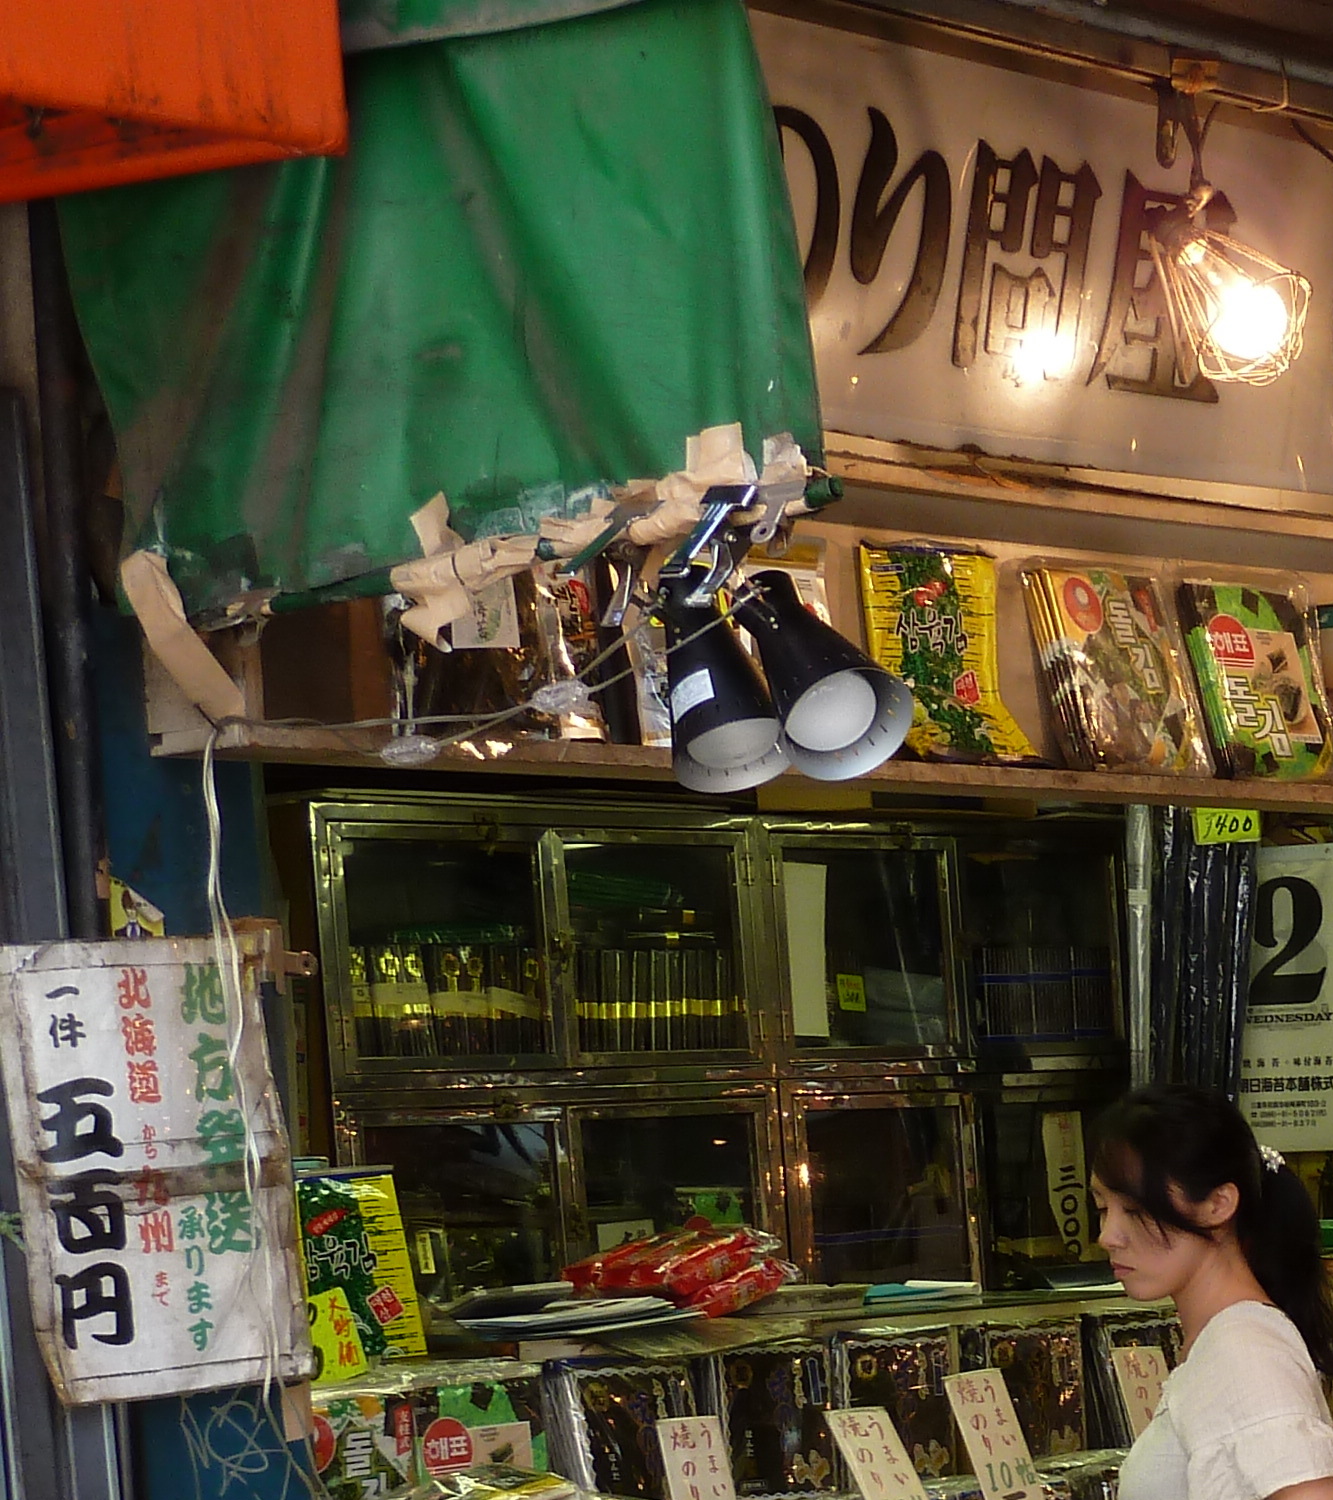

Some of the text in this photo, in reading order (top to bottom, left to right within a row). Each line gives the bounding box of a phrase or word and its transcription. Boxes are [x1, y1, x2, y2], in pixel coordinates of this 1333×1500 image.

[896, 610, 965, 655] 삼육김
[1108, 598, 1164, 690] 돌김
[1210, 630, 1250, 655] 해표
[1223, 675, 1293, 758] 돌김
[1249, 875, 1327, 1007] 2
[36, 984, 135, 1351] 一件 五百円
[117, 967, 175, 1308] 北海道 から 九州 まで
[178, 1206, 214, 1353] 承ります
[427, 1436, 468, 1460] 해표
[842, 1412, 884, 1491] 焼のり
[869, 1415, 909, 1486] うまい
[959, 1380, 1037, 1491] 焼のり 10帖
[984, 1380, 1016, 1447] うまい
[701, 1421, 726, 1497] うまい
